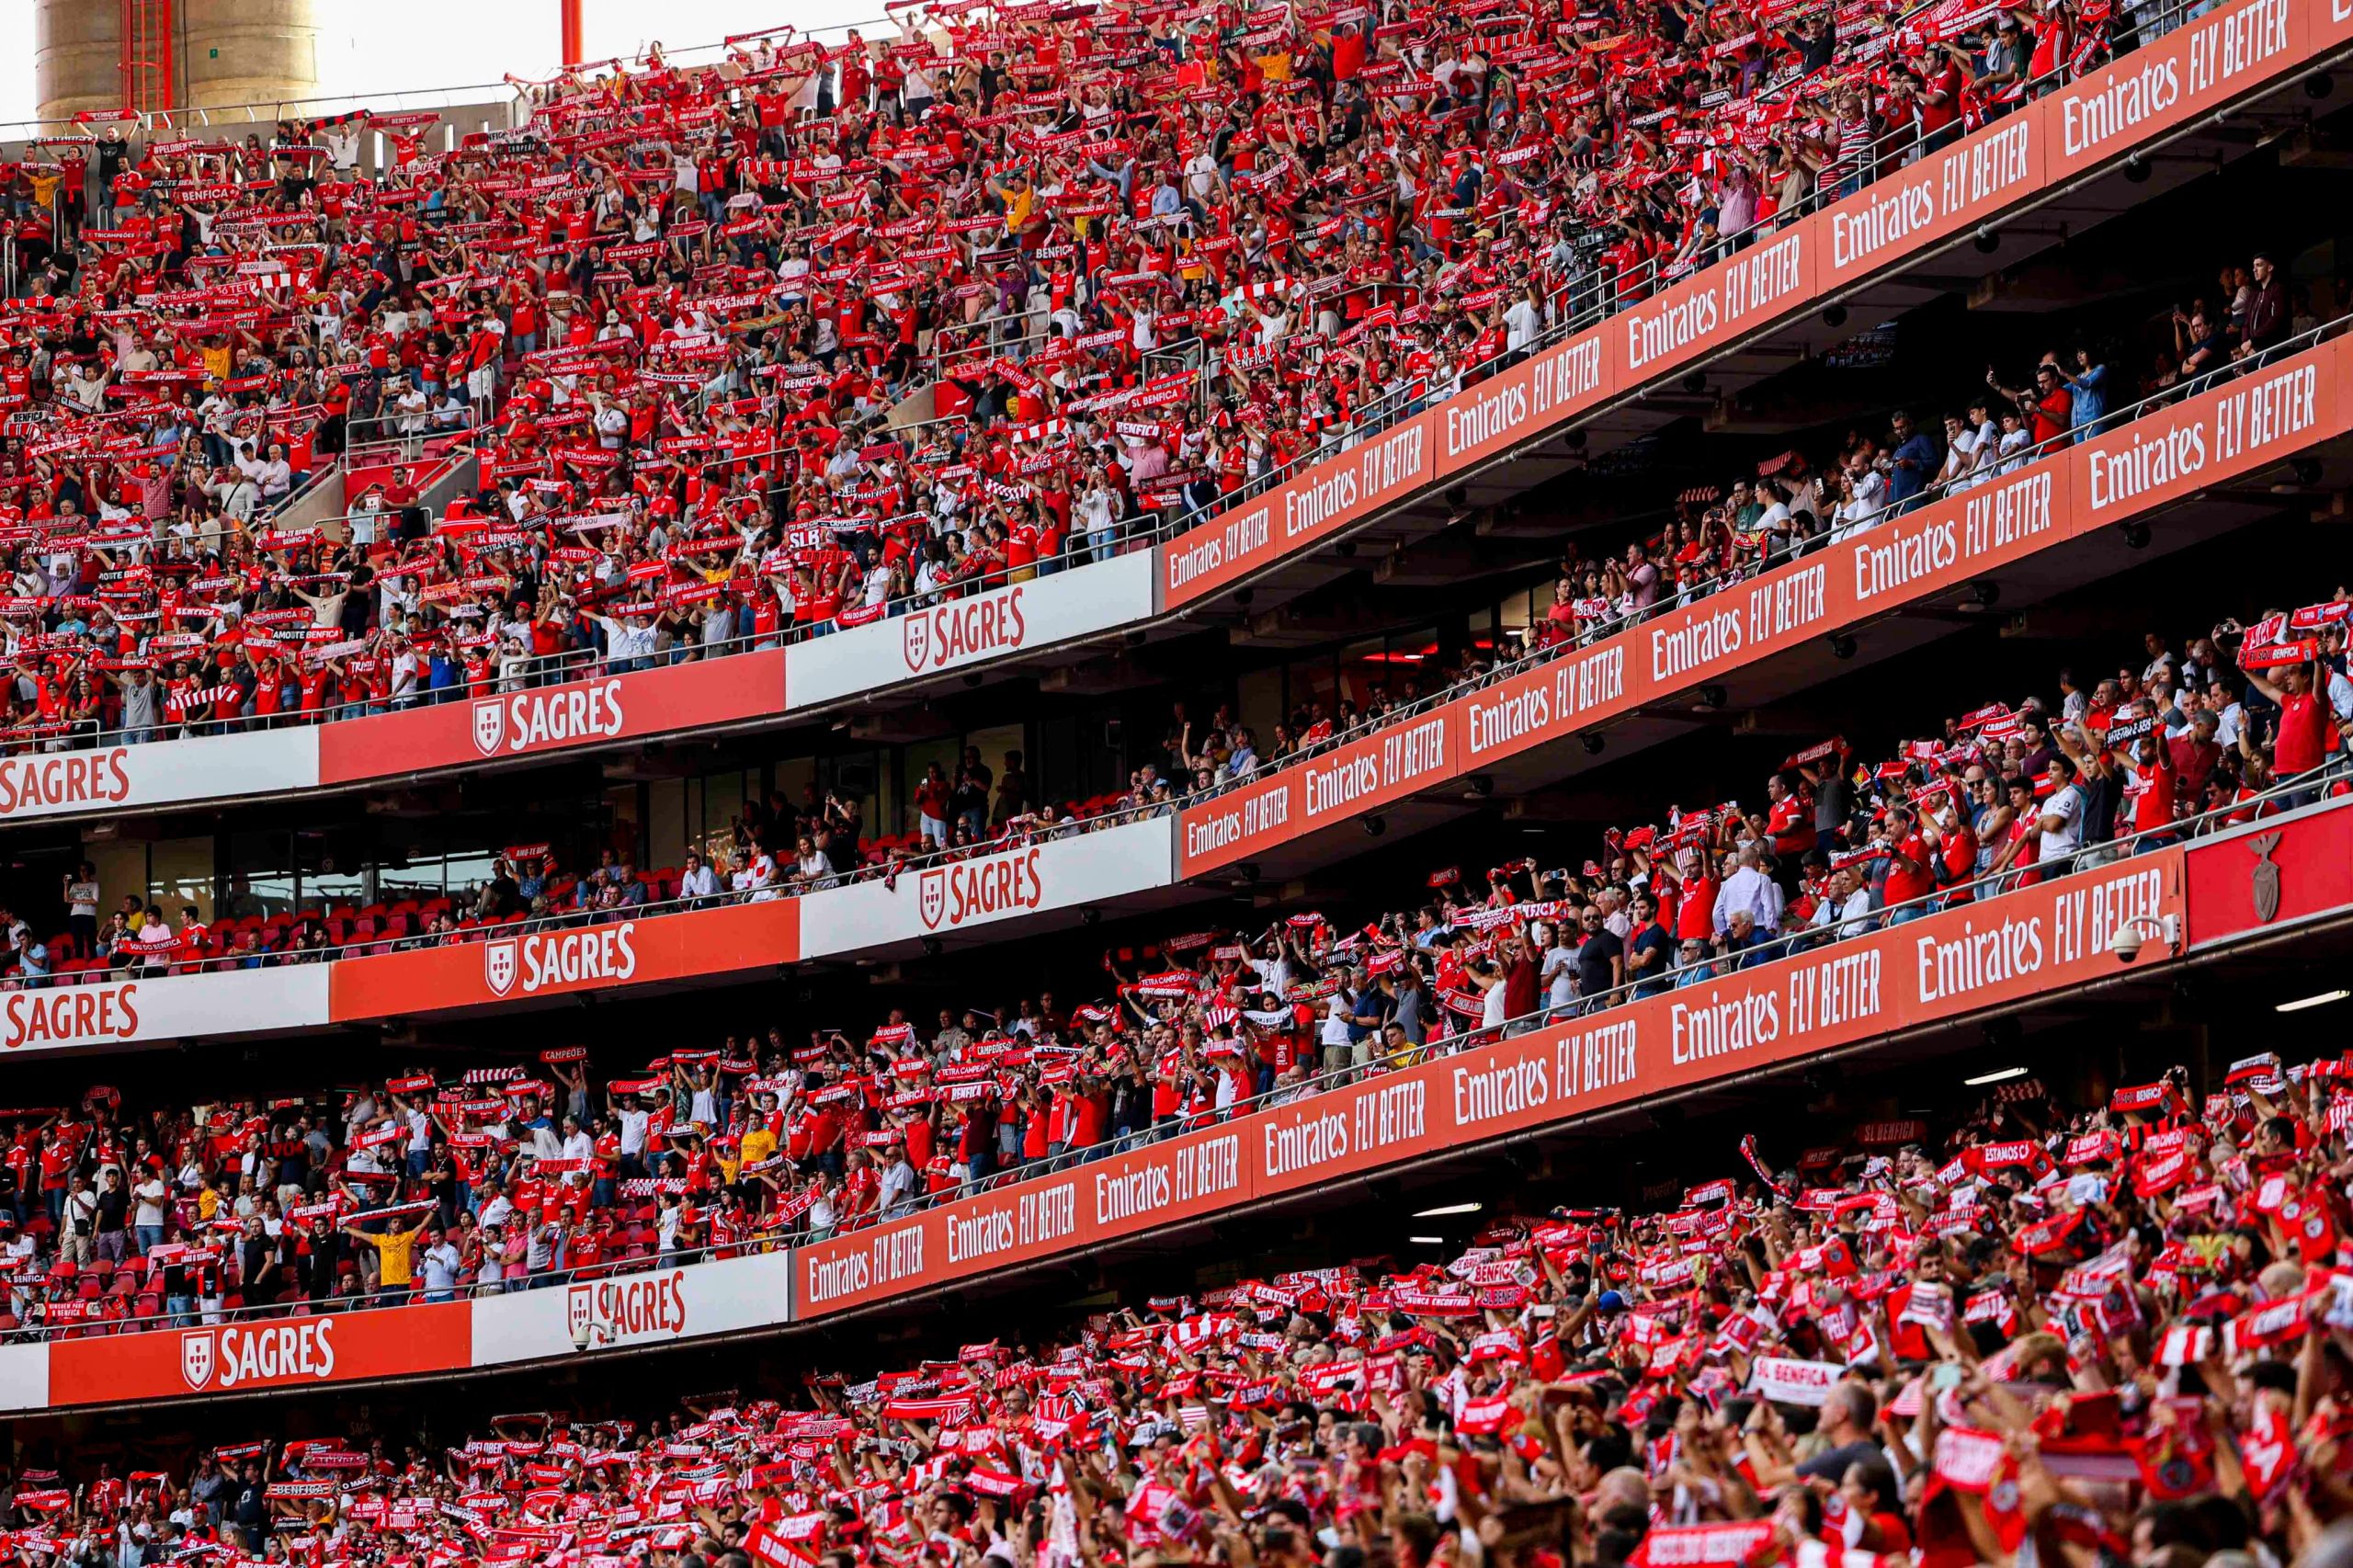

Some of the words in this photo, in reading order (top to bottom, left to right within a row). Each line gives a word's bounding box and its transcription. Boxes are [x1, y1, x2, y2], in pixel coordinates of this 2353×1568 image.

[1836, 20, 1868, 36] BENFICA
[1512, 49, 1537, 57] BENFICA
[2063, 58, 2177, 156] Emirates
[2189, 23, 2218, 95] FLY
[2223, 0, 2287, 78] BETTER
[1397, 82, 1435, 92] BENFICA
[1087, 141, 1118, 154] TETRA
[1500, 147, 1539, 165] BENFICA
[406, 162, 441, 172] BENFICA
[183, 190, 228, 201] BENFICA
[1833, 180, 1933, 268] Emirates
[1943, 150, 1968, 216] FLY
[1972, 120, 2028, 202] BETTER
[220, 207, 263, 219] BENFICA
[285, 213, 310, 222] SEMPRE
[875, 229, 882, 238] SL
[884, 224, 923, 236] BENFICA
[608, 247, 654, 257] CAMPEÕES
[926, 246, 951, 256] BENFICA
[1629, 289, 1716, 369] Emirates
[1725, 261, 1747, 323] FLY
[1751, 234, 1800, 309] BETTER
[233, 312, 258, 320] BENFICA
[551, 346, 578, 356] BENFICA
[995, 363, 1030, 386] GLORIOSO
[784, 377, 822, 388] BENFICA
[1131, 399, 1142, 407] SL
[1143, 391, 1177, 403] BENFICA
[1448, 382, 1526, 456] Emirates
[1534, 360, 1553, 415] FLY
[1556, 337, 1599, 404] BETTER
[15, 412, 42, 422] BENFICA
[1117, 422, 1159, 436] BENFICA
[2090, 423, 2204, 509] Emirates
[2217, 392, 2245, 461] FLY
[2251, 365, 2314, 449] BETTER
[1021, 460, 1051, 472] BENFICA
[407, 468, 415, 484] 7
[1287, 468, 1356, 537] Emirates
[1363, 449, 1381, 498] FLY
[1383, 426, 1422, 489] BETTER
[489, 532, 522, 542] BENFICA
[789, 529, 820, 548] SLB
[1855, 520, 1955, 600] Emirates
[1966, 494, 1990, 557] FLY
[1995, 472, 2051, 547] BETTER
[703, 540, 728, 549] BENFICA
[1170, 539, 1221, 588] Emirates
[1226, 522, 1238, 562] FLY
[1241, 508, 1267, 555] BETTER
[568, 550, 590, 558] TETRA
[375, 567, 395, 577] TETRA
[192, 581, 230, 589] BENFICA
[266, 611, 297, 620] BENFICA
[1653, 608, 1741, 681] Emirates
[1750, 585, 1771, 644] FLY
[1776, 563, 1824, 633] BETTER
[934, 586, 1025, 666] SAGRES
[306, 631, 339, 639] BENFICA
[2273, 646, 2298, 659] BENFICA
[122, 658, 149, 667] BENFICA
[1470, 687, 1548, 753] Emirates
[1556, 665, 1575, 720] FLY
[1579, 646, 1622, 710] BETTER
[510, 679, 623, 751] SAGRES
[1985, 719, 2015, 733] CARREGA
[1306, 754, 1377, 816] Emirates
[1384, 734, 1402, 786] FLY
[1404, 719, 1443, 778] BETTER
[0, 748, 129, 813] SAGRES
[1188, 812, 1240, 858] Emirates
[1245, 798, 1257, 836] FLY
[1260, 786, 1287, 830] BETTER
[949, 847, 1040, 925] SAGRES
[1917, 915, 2041, 1003] Emirates
[2055, 890, 2086, 964] FLY
[2092, 869, 2161, 955] BETTER
[129, 940, 142, 952] SOU
[155, 937, 182, 949] BENFICA
[523, 922, 635, 992] SAGRES
[1671, 988, 1779, 1064] Emirates
[1790, 967, 1815, 1035] FLY
[1821, 949, 1880, 1027] BETTER
[6, 983, 139, 1049] SAGRES
[545, 1048, 586, 1060] CAMPEÕES
[942, 1068, 959, 1076] TETRA
[960, 1063, 988, 1074] CAMPEÃO
[1454, 1055, 1547, 1125] Emirates
[1558, 1036, 1580, 1099] FLY
[1585, 1020, 1635, 1091] BETTER
[406, 1078, 427, 1088] BENFICA
[886, 1097, 894, 1106] SL
[895, 1089, 924, 1104] BENFICA
[951, 1085, 982, 1099] BENFICA
[2136, 1086, 2162, 1101] BENFICA
[1265, 1110, 1347, 1176] Emirates
[1356, 1093, 1375, 1152] FLY
[1380, 1080, 1424, 1145] BETTER
[1985, 1147, 2018, 1162] ESTAMOS
[1097, 1162, 1169, 1223] Emirates
[1176, 1146, 1194, 1201] FLY
[1198, 1135, 1237, 1196] BETTER
[948, 1207, 1013, 1263] Emirates
[1020, 1194, 1035, 1244] FLY
[1039, 1183, 1074, 1241] BETTER
[810, 1251, 868, 1302] Emirates
[874, 1235, 888, 1284] FLY
[892, 1225, 922, 1279] BETTER
[14, 1275, 45, 1283] BENFICA
[1256, 1287, 1294, 1305] BENFICA
[221, 1318, 335, 1387] SAGRES
[1757, 1358, 1770, 1375] SL
[1775, 1361, 1829, 1386] BENFICA
[811, 1424, 841, 1434] BENFICA
[278, 1485, 324, 1494] BENFICA
